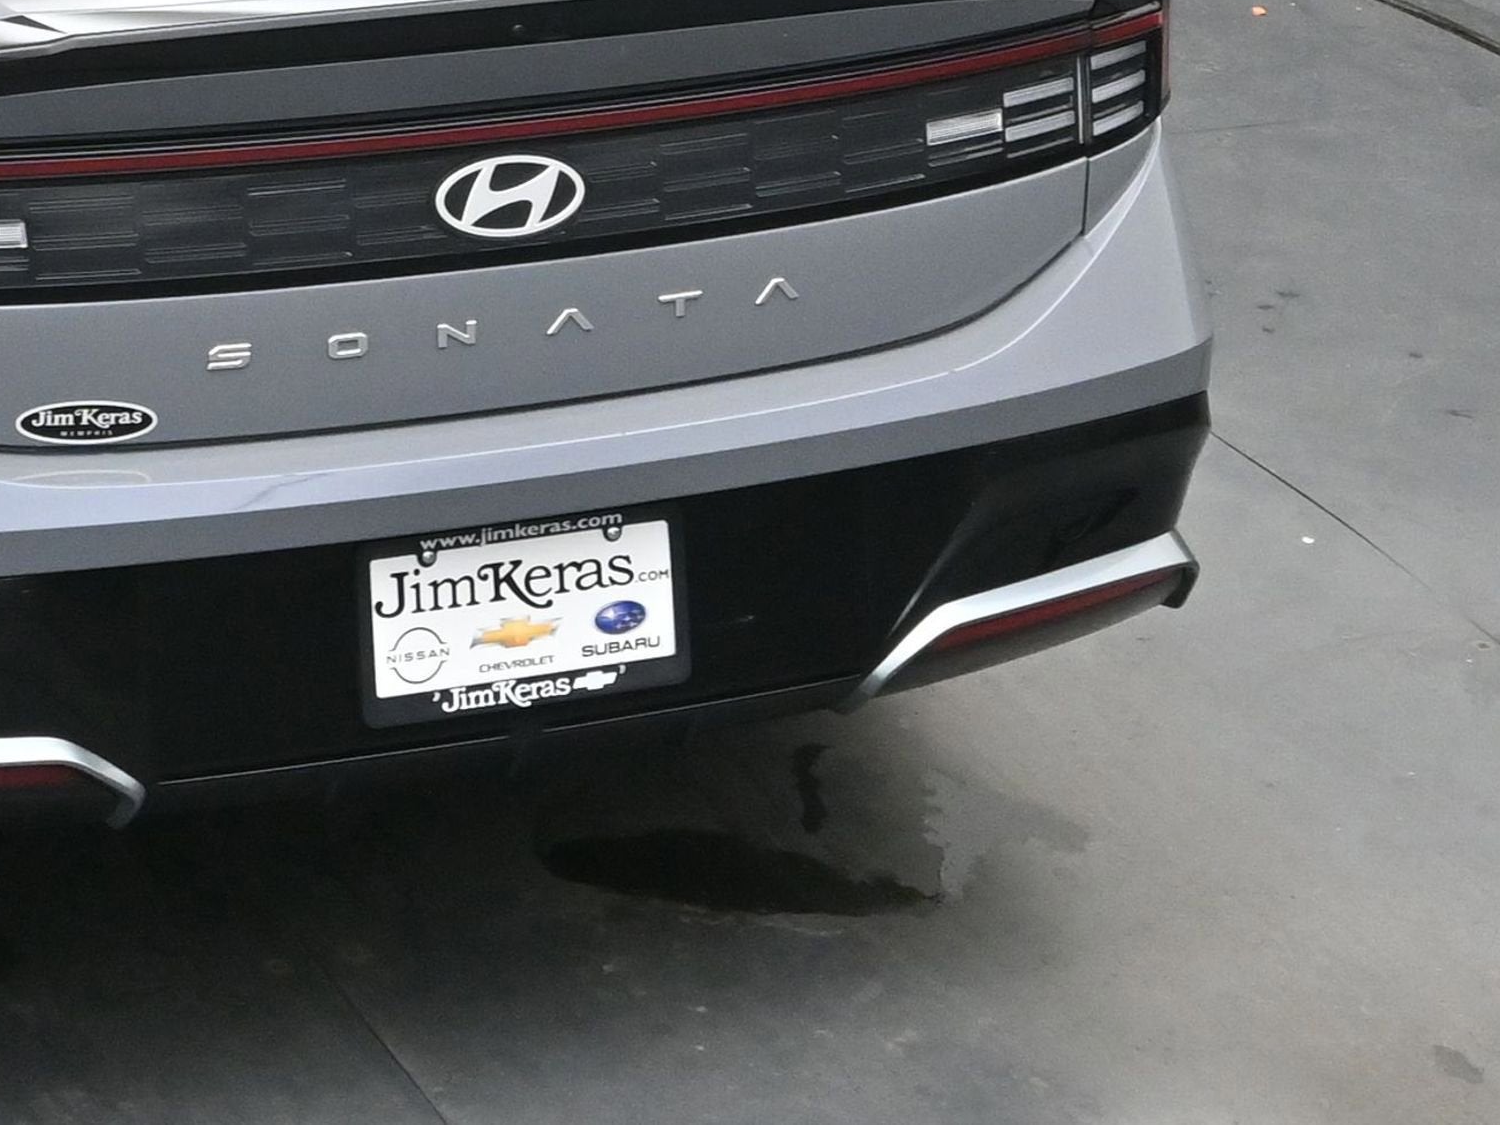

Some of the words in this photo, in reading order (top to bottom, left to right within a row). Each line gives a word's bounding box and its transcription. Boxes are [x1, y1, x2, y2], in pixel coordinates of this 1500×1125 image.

[206, 277, 799, 371] SONATA
[420, 513, 623, 547] www.jimkeras.com
[386, 648, 450, 664] NISSAN
[581, 636, 661, 657] SUBARU
[478, 655, 555, 673] CHEVROLET
